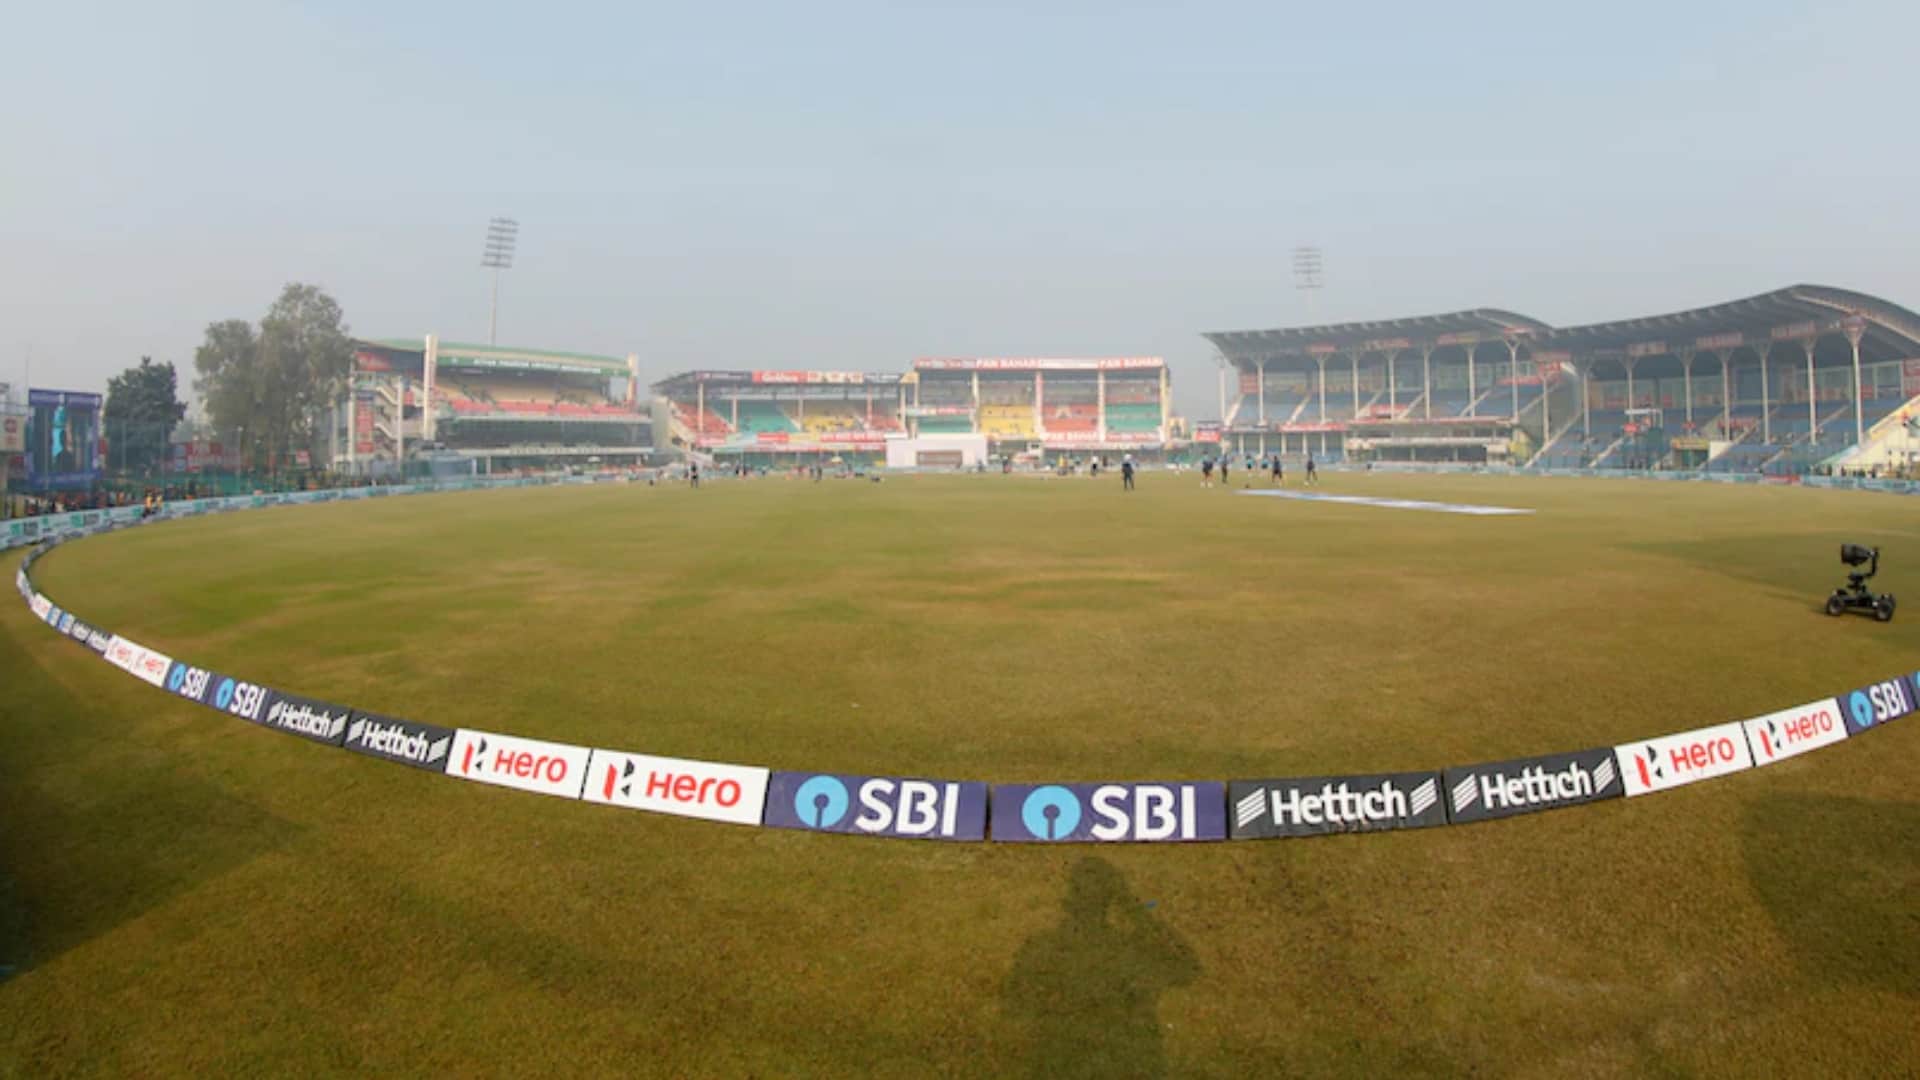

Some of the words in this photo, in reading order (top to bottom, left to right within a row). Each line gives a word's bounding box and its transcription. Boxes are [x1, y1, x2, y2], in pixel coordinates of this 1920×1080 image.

[180, 666, 210, 700] SBI
[229, 681, 267, 720] SBI
[1870, 679, 1909, 722] SBI
[277, 701, 333, 739] Hettich
[1784, 709, 1833, 745] Hero
[361, 719, 430, 763] Hettich
[1669, 736, 1736, 773] Hero
[493, 748, 568, 783] Hero
[1480, 760, 1593, 810] Hettich
[645, 770, 742, 808] Hero
[855, 777, 961, 837] SBI
[1271, 778, 1407, 826] Hettich
[1090, 784, 1196, 841] SBI
